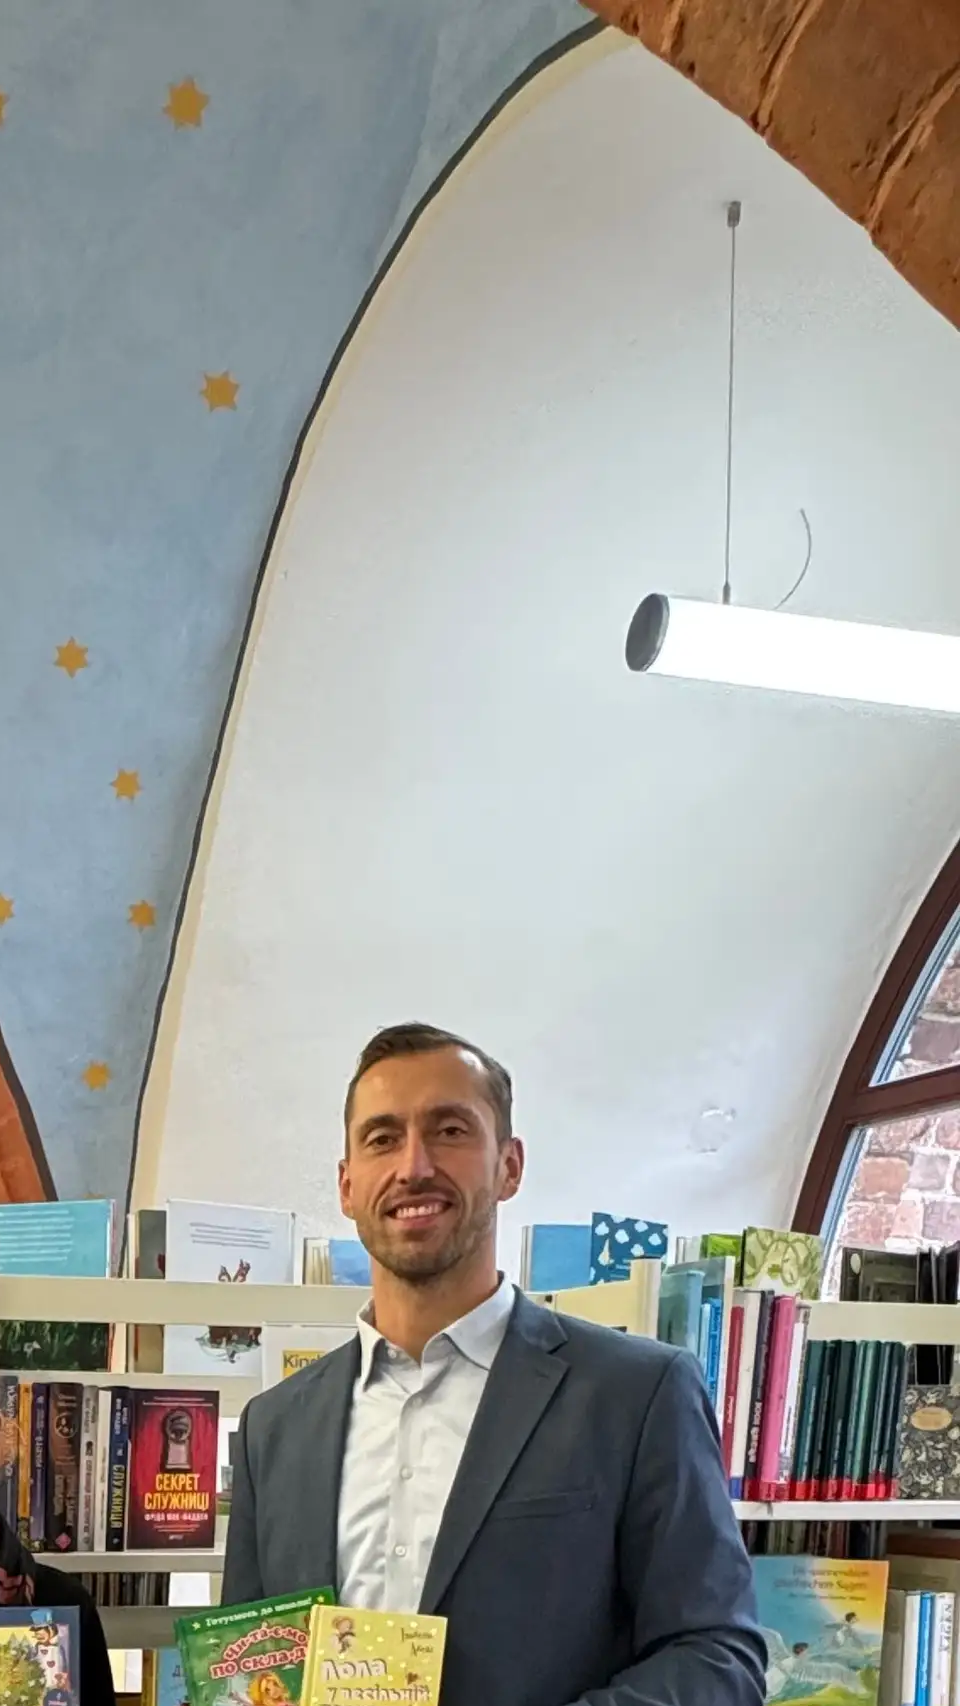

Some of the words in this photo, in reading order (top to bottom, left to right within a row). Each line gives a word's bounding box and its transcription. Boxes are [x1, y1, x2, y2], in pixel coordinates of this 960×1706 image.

[156, 1473, 200, 1491] СЕКРЕТ
[144, 1492, 209, 1510] СЛУЖНИЦІ
[323, 1658, 388, 1681] Лола
